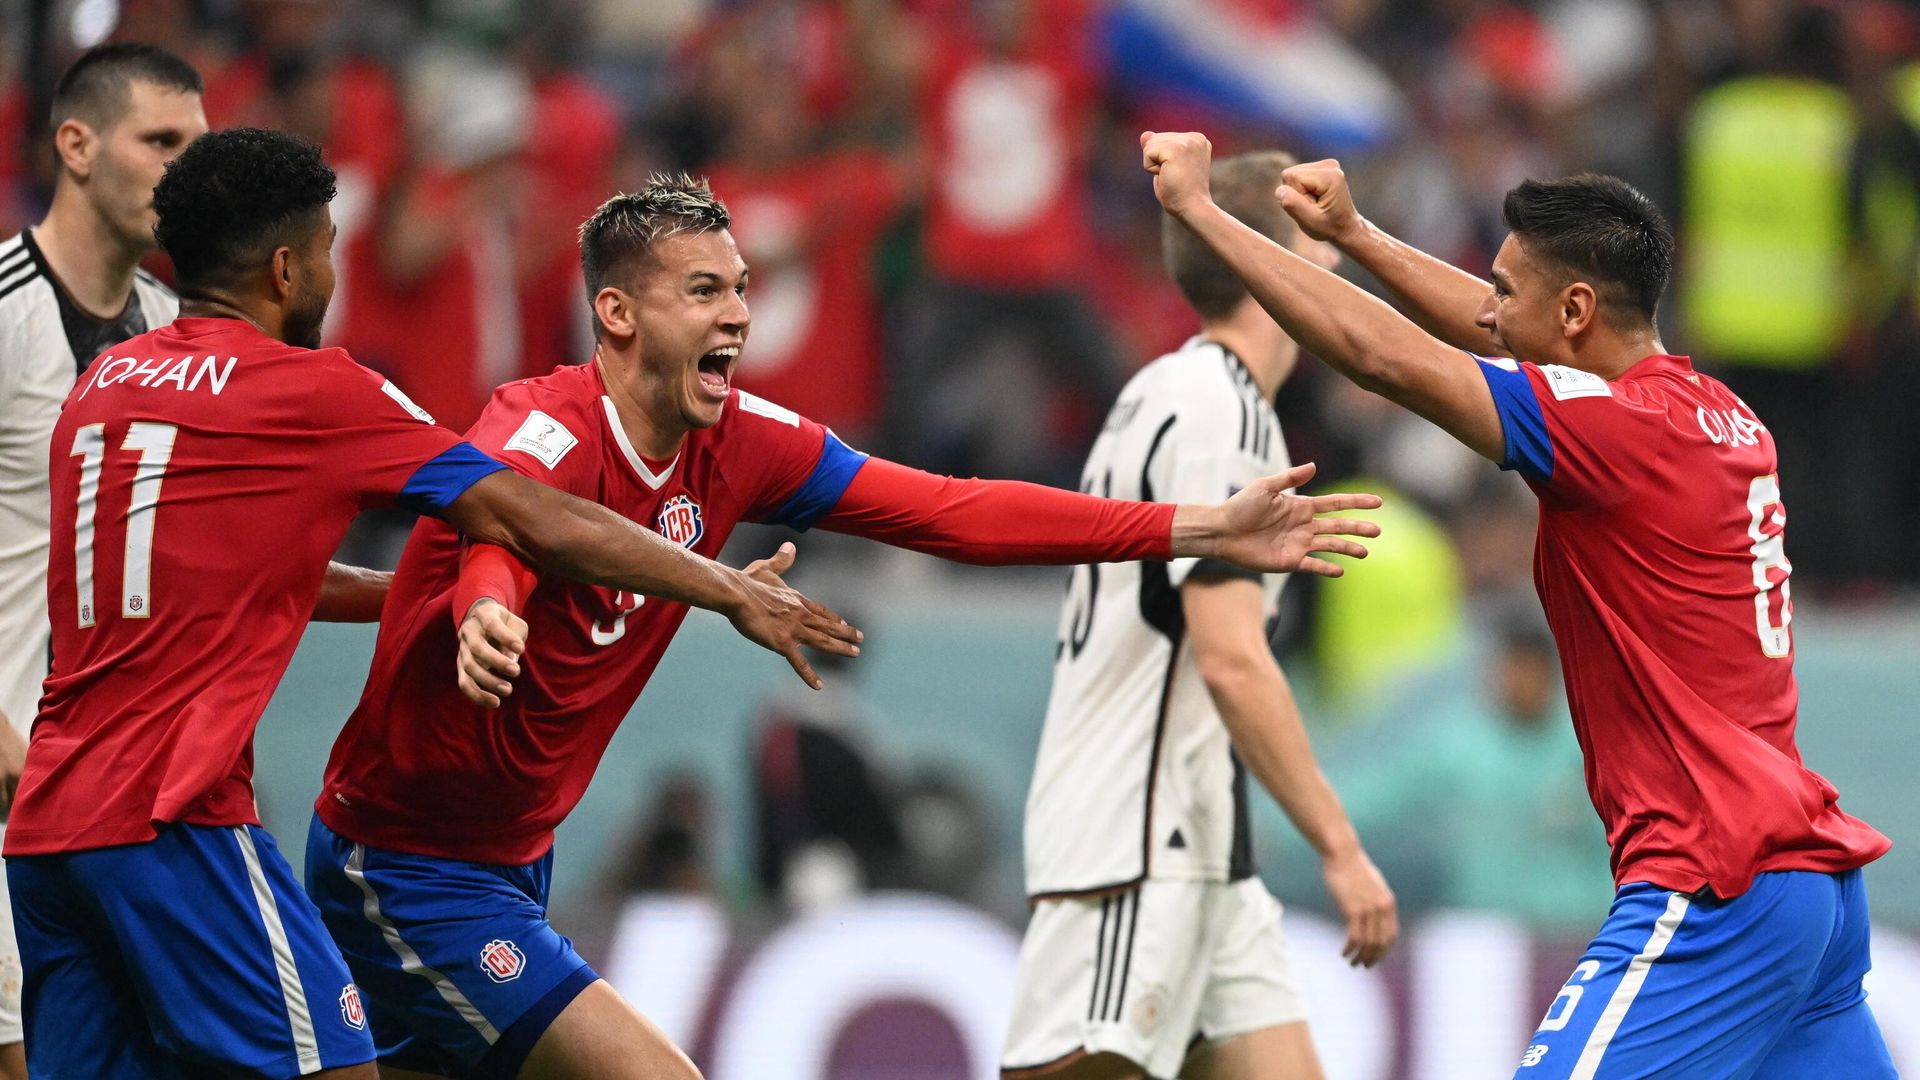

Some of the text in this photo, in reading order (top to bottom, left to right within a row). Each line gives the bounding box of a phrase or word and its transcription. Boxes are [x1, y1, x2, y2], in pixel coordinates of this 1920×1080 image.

[78, 355, 238, 402] JOHAN
[70, 421, 179, 629] 11
[667, 507, 693, 543] CR
[487, 946, 517, 974] CR
[1537, 960, 1600, 1031] 6
